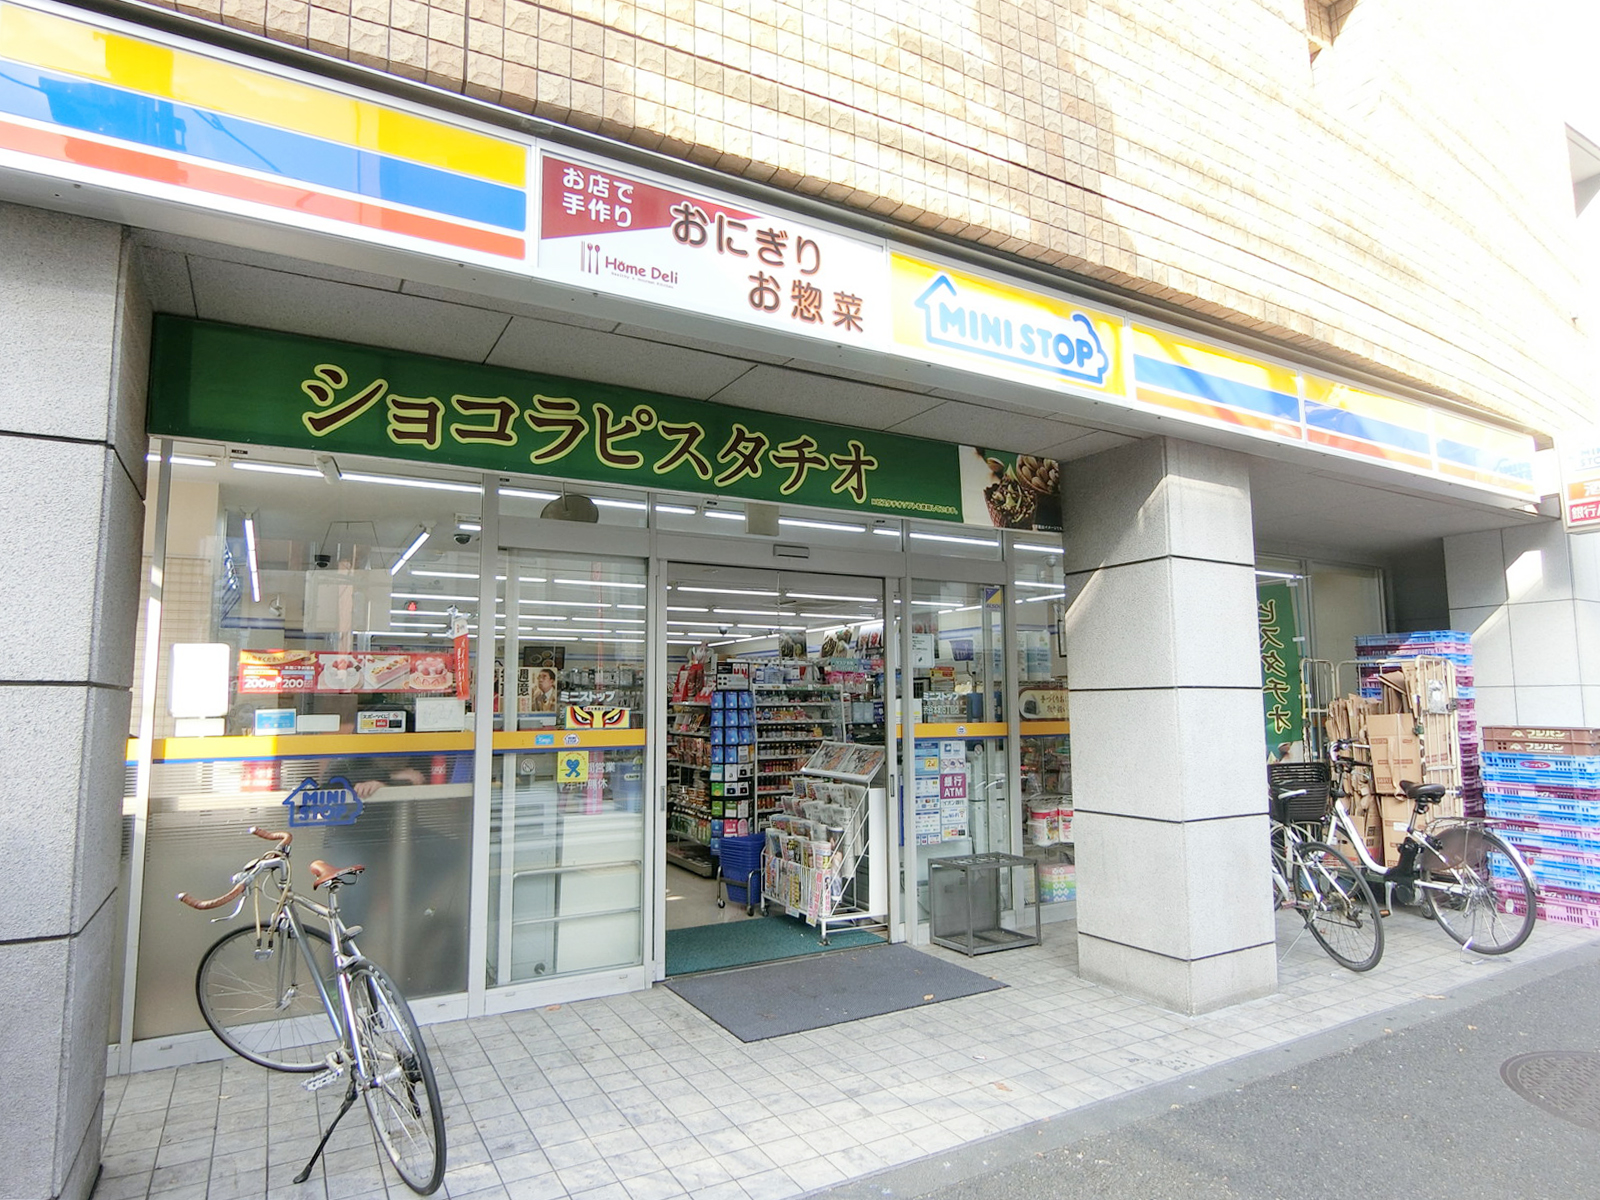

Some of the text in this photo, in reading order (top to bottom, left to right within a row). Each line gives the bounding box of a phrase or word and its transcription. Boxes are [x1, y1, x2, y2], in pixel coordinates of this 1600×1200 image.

[562, 167, 634, 204] お店で
[562, 191, 633, 228] 手作り
[670, 201, 822, 276] おにぎり
[651, 266, 678, 284] Deli
[748, 270, 863, 333] お惣菜
[939, 301, 1093, 368] MINI STOP
[301, 363, 878, 504] ショコラピスタチオ
[560, 690, 616, 702] ミニストップ
[1526, 729, 1566, 738] フジパン
[1525, 743, 1564, 751] フジパン
[943, 776, 963, 787] 銀行
[302, 790, 346, 805] MINI
[944, 787, 963, 797] ATM
